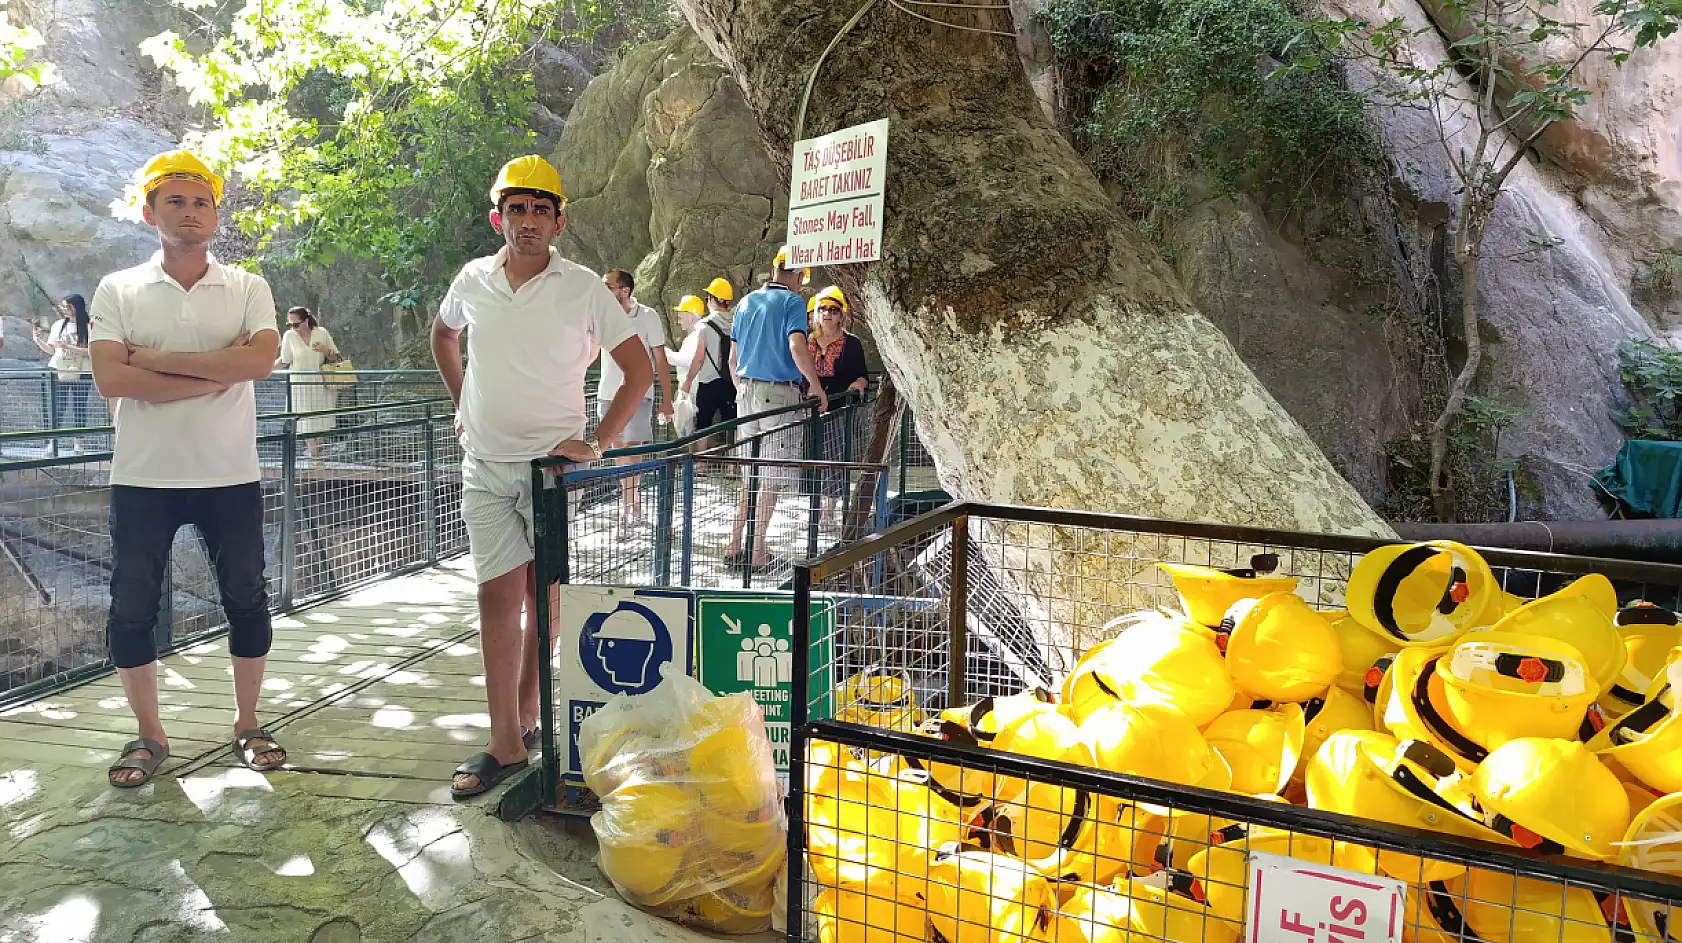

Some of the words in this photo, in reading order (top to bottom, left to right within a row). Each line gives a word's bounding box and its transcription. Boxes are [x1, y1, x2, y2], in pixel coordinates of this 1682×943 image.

[822, 132, 874, 169] DÜŞEBİLİR
[801, 176, 830, 201] BARET
[832, 167, 872, 194] TAKINIZ
[793, 216, 824, 235] Stones
[827, 210, 849, 234] May
[852, 204, 876, 228] Fall,
[791, 245, 814, 264] Wear
[817, 242, 823, 261] A
[827, 237, 851, 260] Hard
